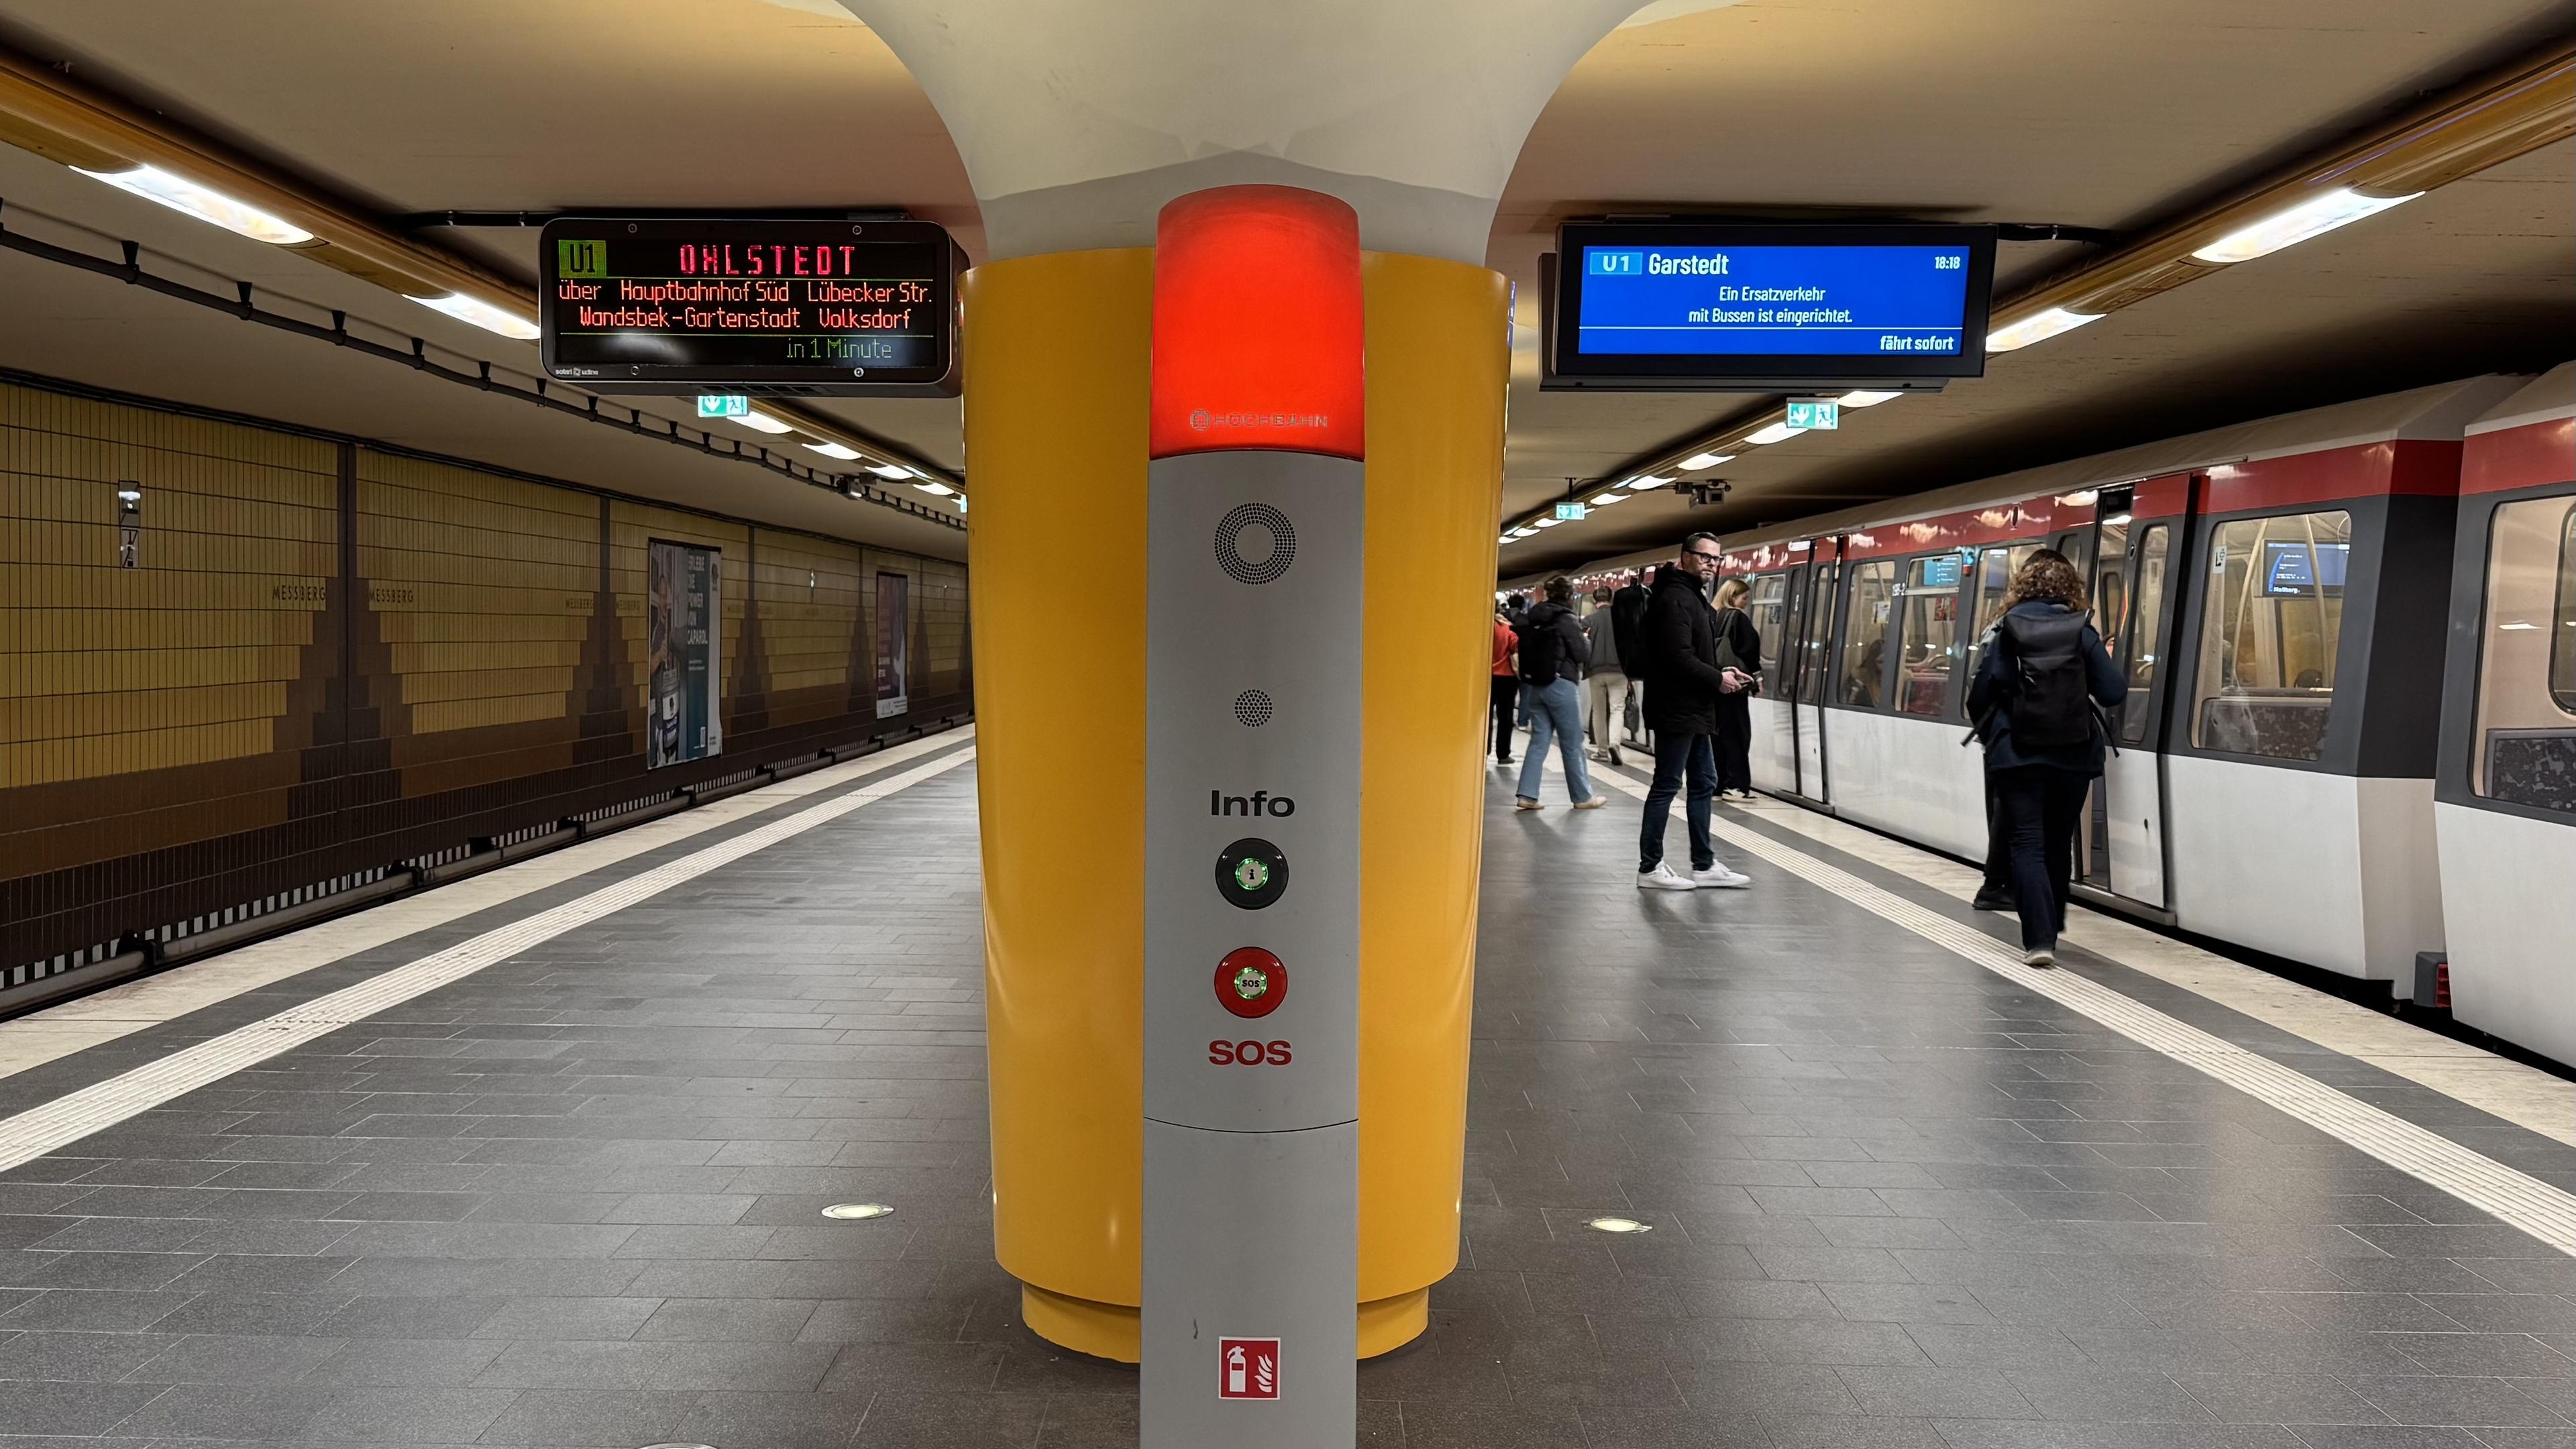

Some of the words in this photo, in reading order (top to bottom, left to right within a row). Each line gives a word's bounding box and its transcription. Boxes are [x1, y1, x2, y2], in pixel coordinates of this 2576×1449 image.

[569, 242, 596, 274] U1
[680, 244, 855, 275] OHLSTEDT
[1648, 253, 1729, 275] Garstedt
[1935, 256, 1961, 269] 18:18
[559, 279, 602, 300] über
[621, 279, 751, 305] Hauptbahnhof
[756, 281, 789, 302] Süd
[808, 281, 895, 303] Lübecker
[899, 282, 932, 303] Str.
[1719, 286, 1738, 301] Ein
[1741, 286, 1826, 302] Ersatzverkehr
[819, 307, 912, 329] Volksdorf
[1688, 308, 1709, 323] mit
[1712, 307, 1754, 323] Bussen
[1758, 308, 1774, 323] ist
[1776, 308, 1853, 327] eingerichtet.
[787, 337, 805, 358] in
[810, 337, 821, 358] 1
[827, 337, 892, 358] Minute
[1880, 335, 1913, 350] fährt
[1914, 335, 1955, 350] sofort
[1213, 413, 1329, 428] HOCHBAHN
[272, 584, 326, 602] MESSBERG
[370, 588, 414, 604] MESSBERG
[1211, 790, 1295, 818] Info
[1241, 978, 1260, 988] SOS
[1208, 1040, 1293, 1066] SOS
